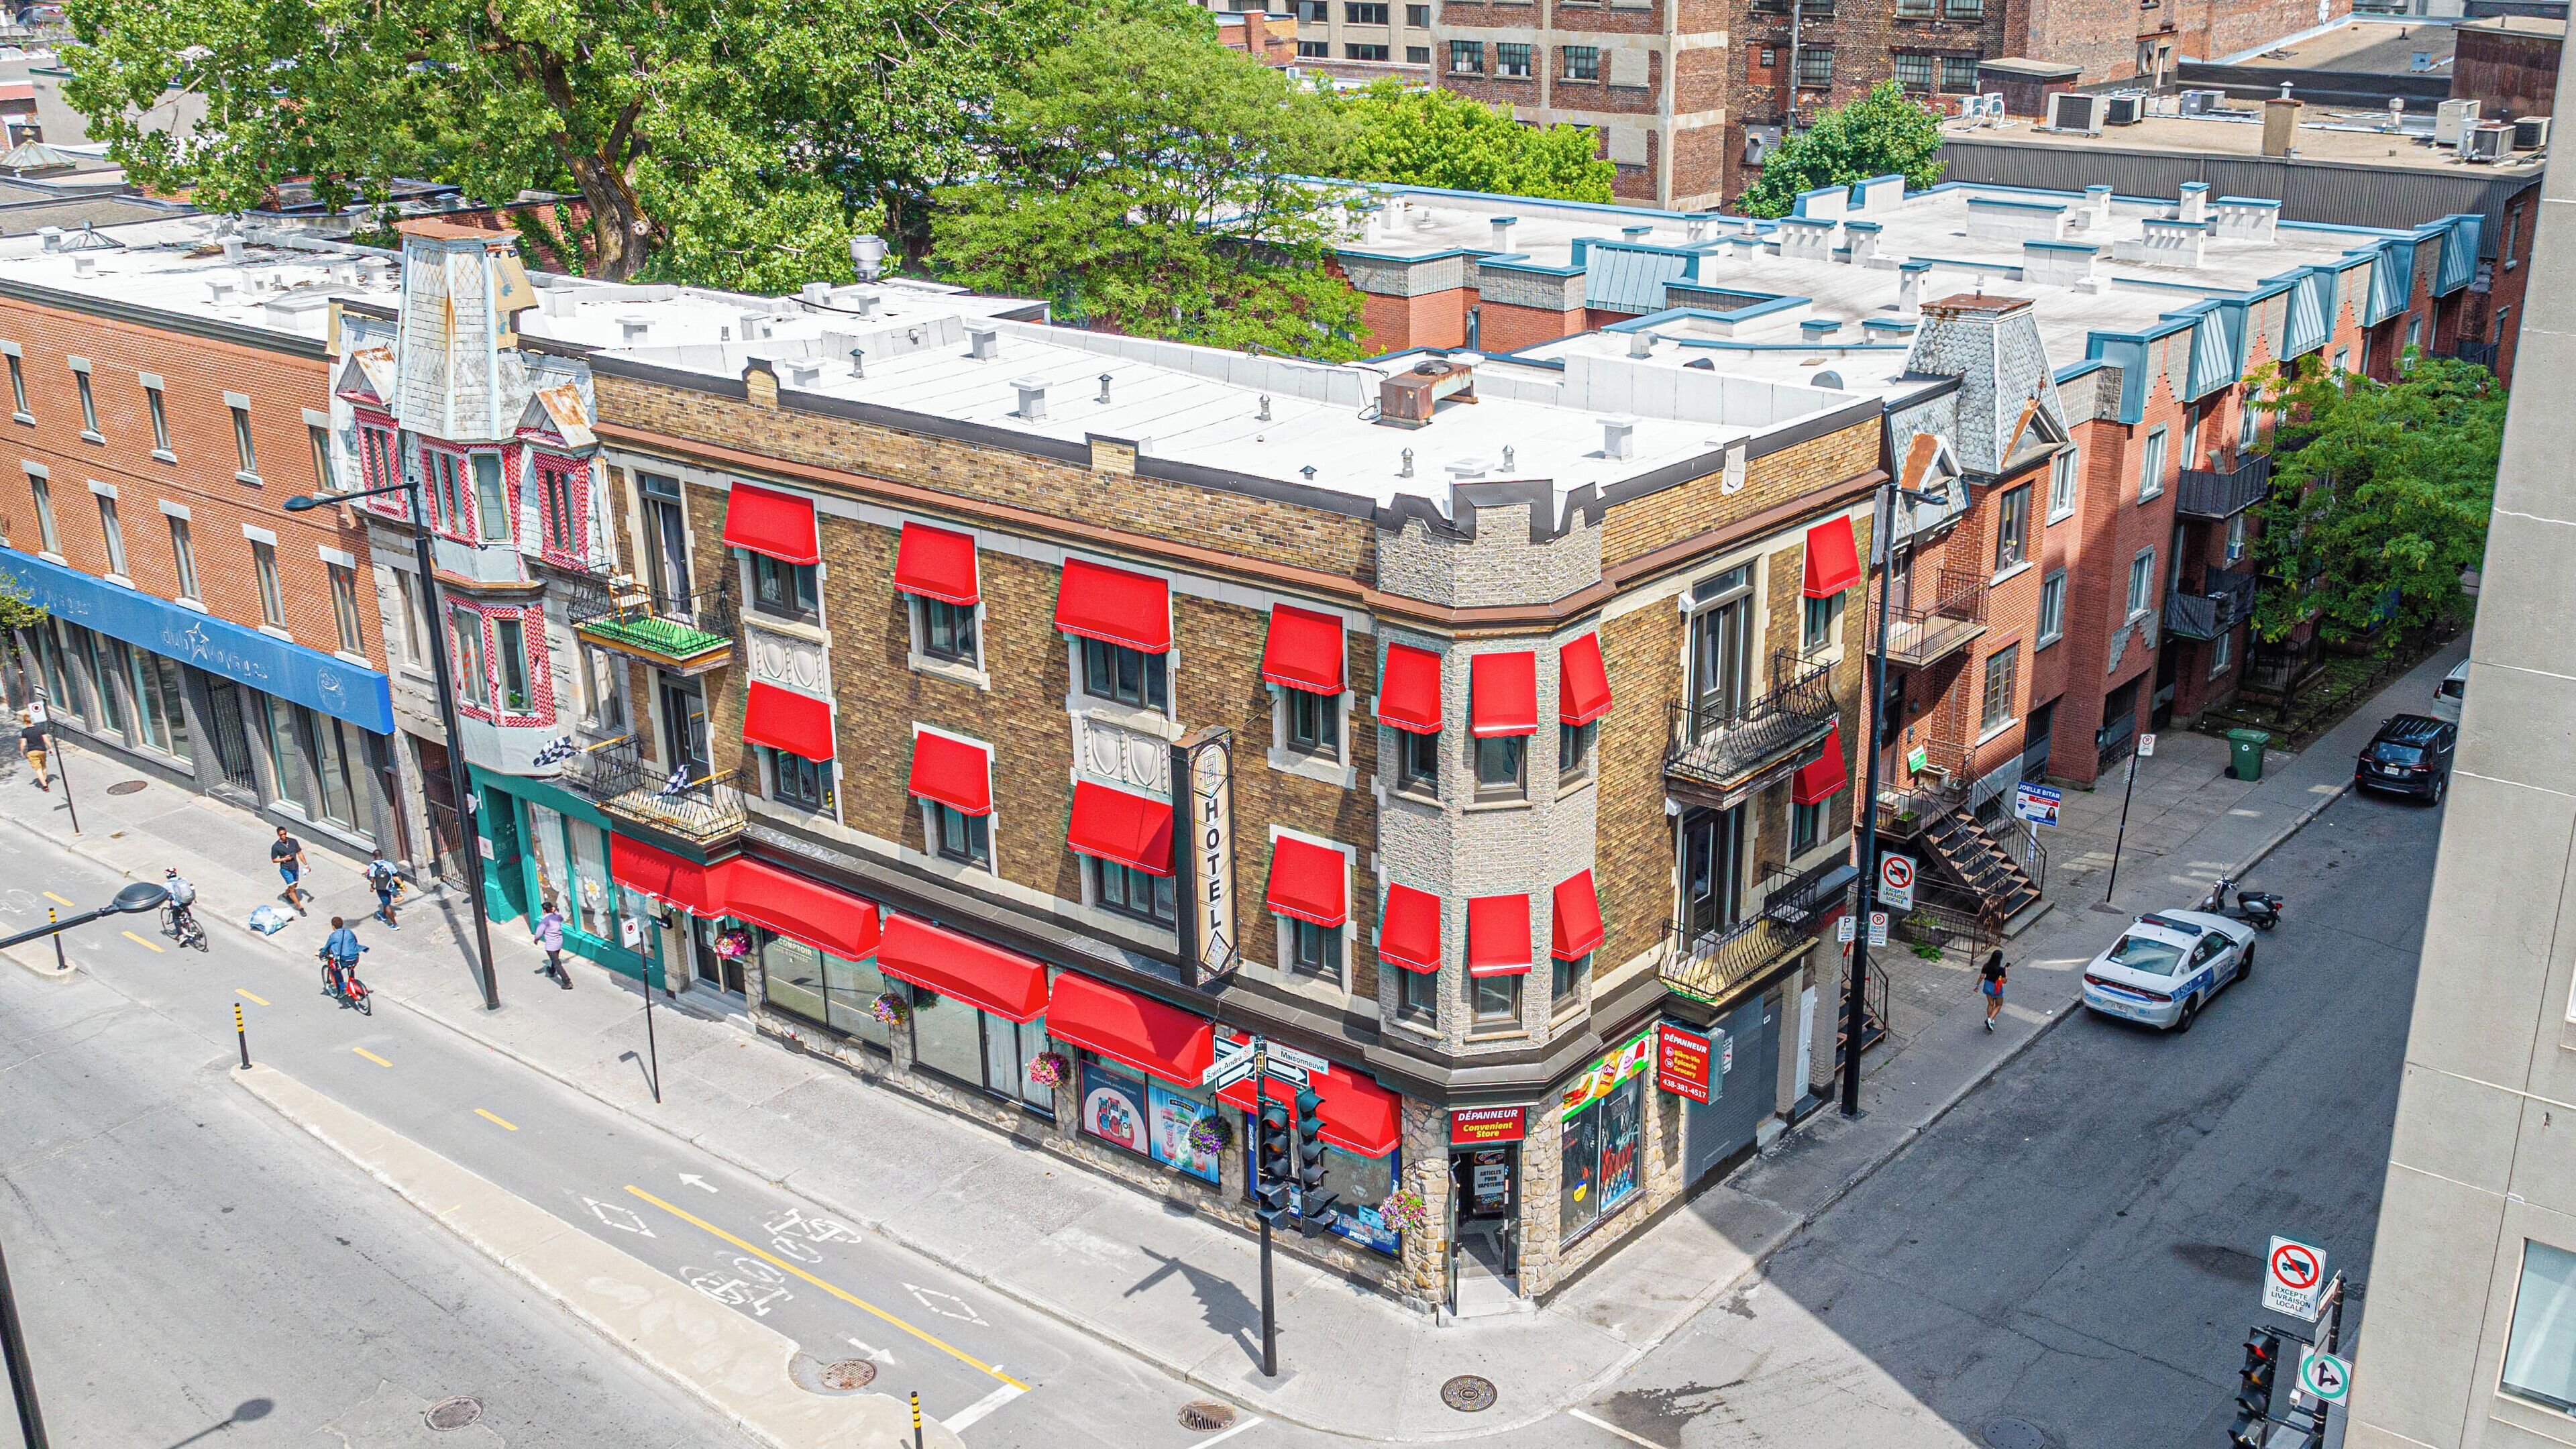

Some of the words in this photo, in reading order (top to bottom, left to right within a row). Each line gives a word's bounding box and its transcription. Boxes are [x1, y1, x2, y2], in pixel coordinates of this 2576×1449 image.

[2018, 784, 2041, 794] JOELLE
[2042, 790, 2060, 799] BITAR
[1205, 798, 1222, 930] HOTEL
[1843, 918, 1851, 926] P
[778, 937, 812, 957] COMPTOIR
[1664, 1032, 1707, 1054] DÉPANNEUR
[1206, 1055, 1242, 1081] Saint-André
[1281, 1051, 1325, 1071] Maisonneuve
[1673, 1065, 1697, 1079] Grocery
[1662, 1078, 1707, 1099] 438-381-4517
[1458, 1110, 1518, 1121] DÉPANNEUR
[1462, 1122, 1513, 1132] Convenient
[1348, 1230, 1373, 1244] PEPSI
[2271, 1291, 2310, 1308] LIVRAISON
[2275, 1299, 2304, 1312] LOCALE
